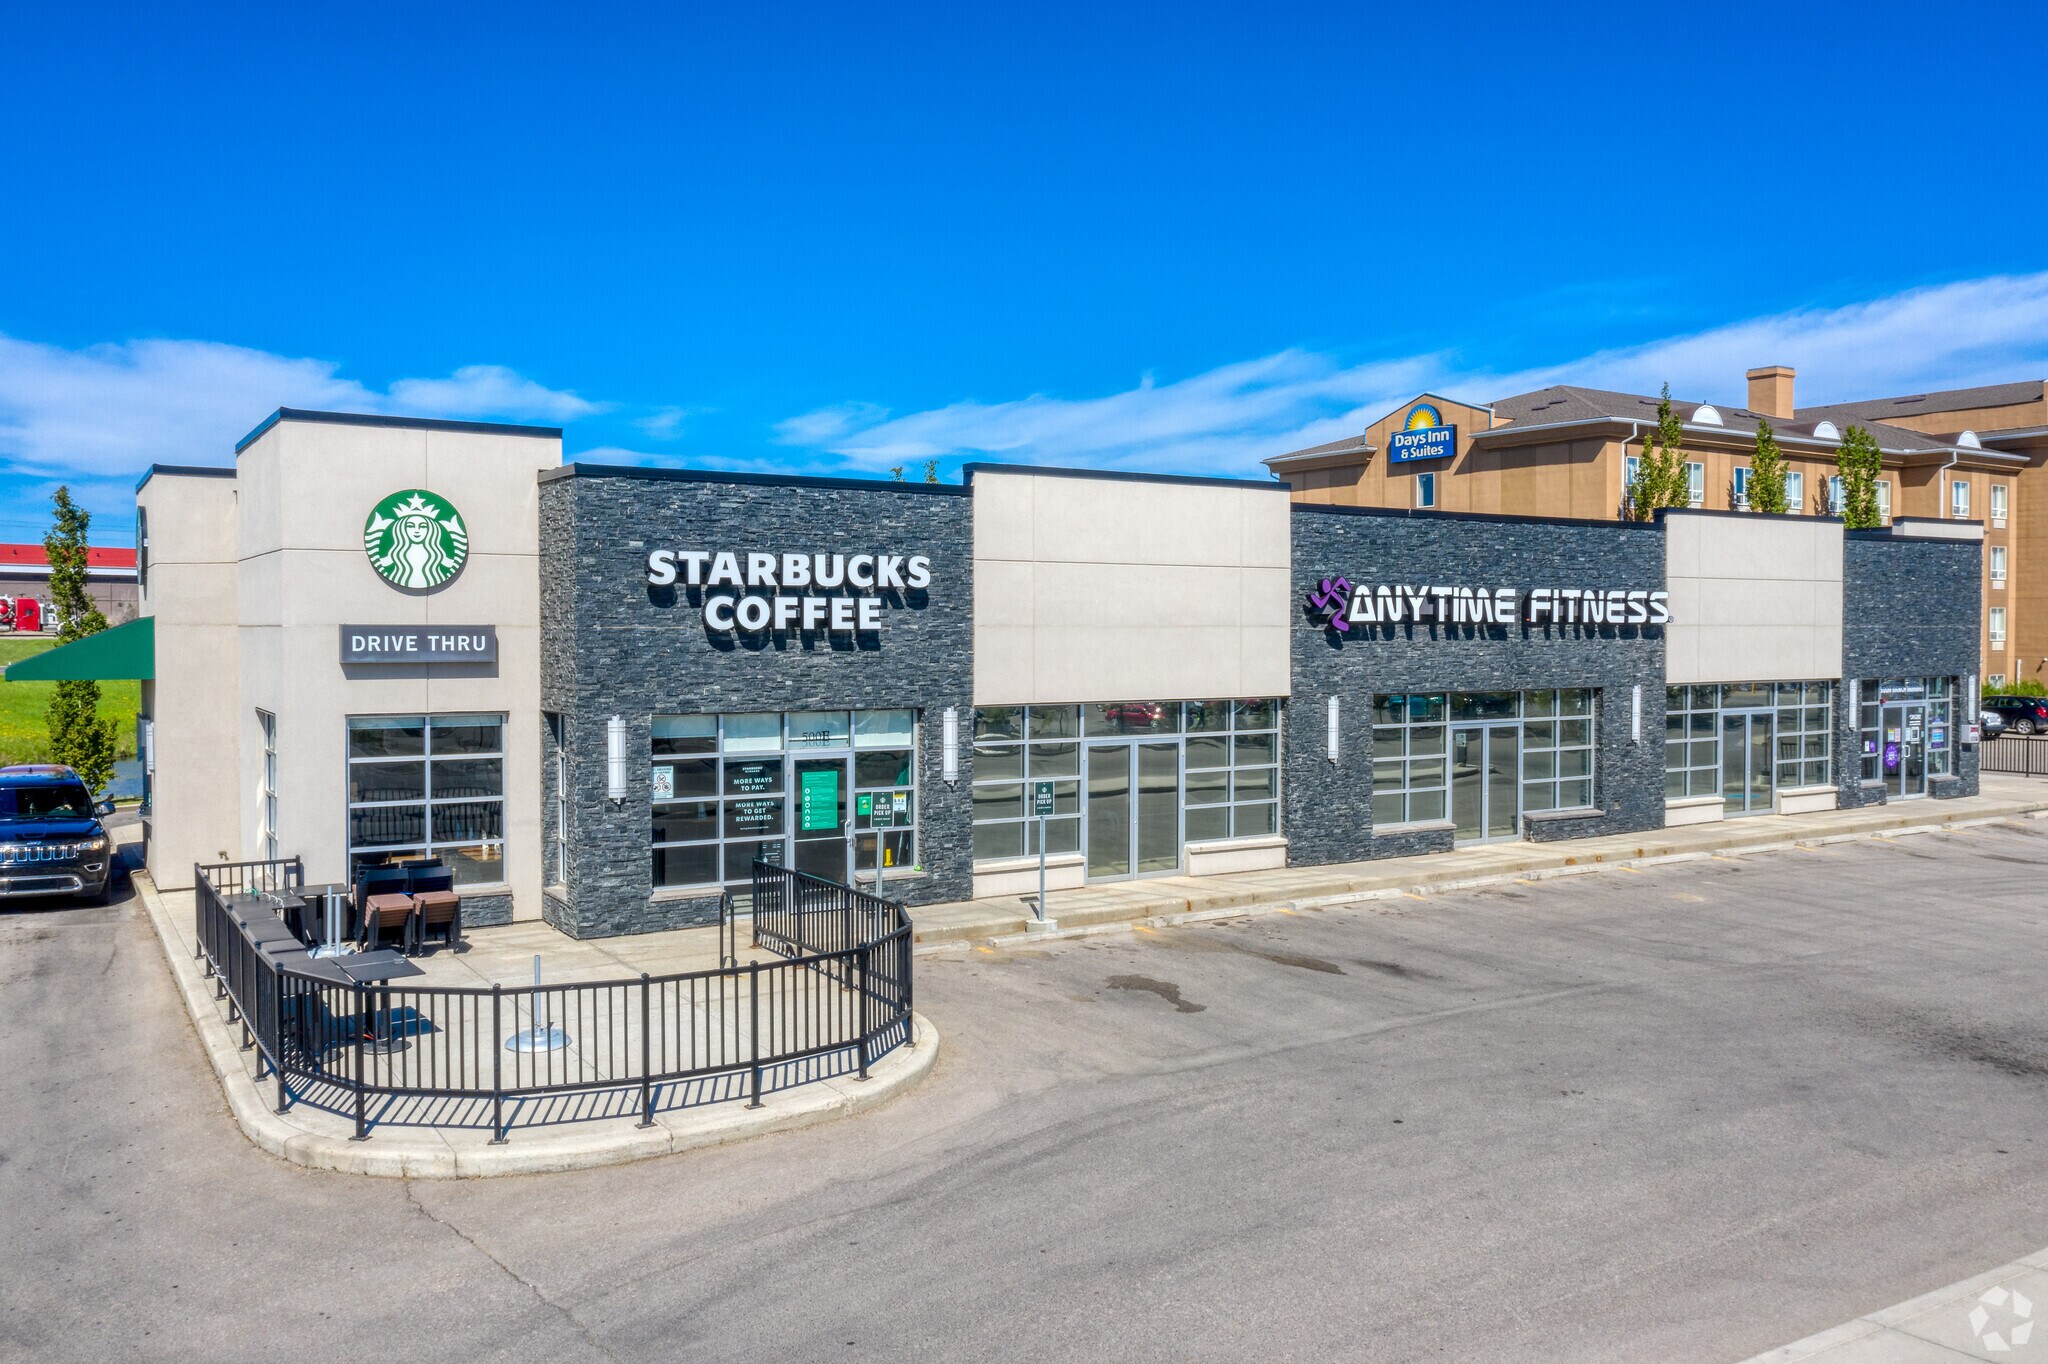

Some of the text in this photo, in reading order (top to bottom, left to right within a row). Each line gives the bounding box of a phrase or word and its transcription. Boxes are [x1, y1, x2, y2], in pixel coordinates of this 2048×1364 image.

[1395, 430, 1449, 447] Days Inn
[1401, 445, 1444, 459] & Suites
[648, 550, 931, 588] STARBUCKS
[1349, 584, 1669, 624] ANYTIME FITNESS
[704, 596, 882, 631] COFFEE
[351, 635, 486, 652] DRIVE THRU
[735, 814, 774, 822] REWARDED.
